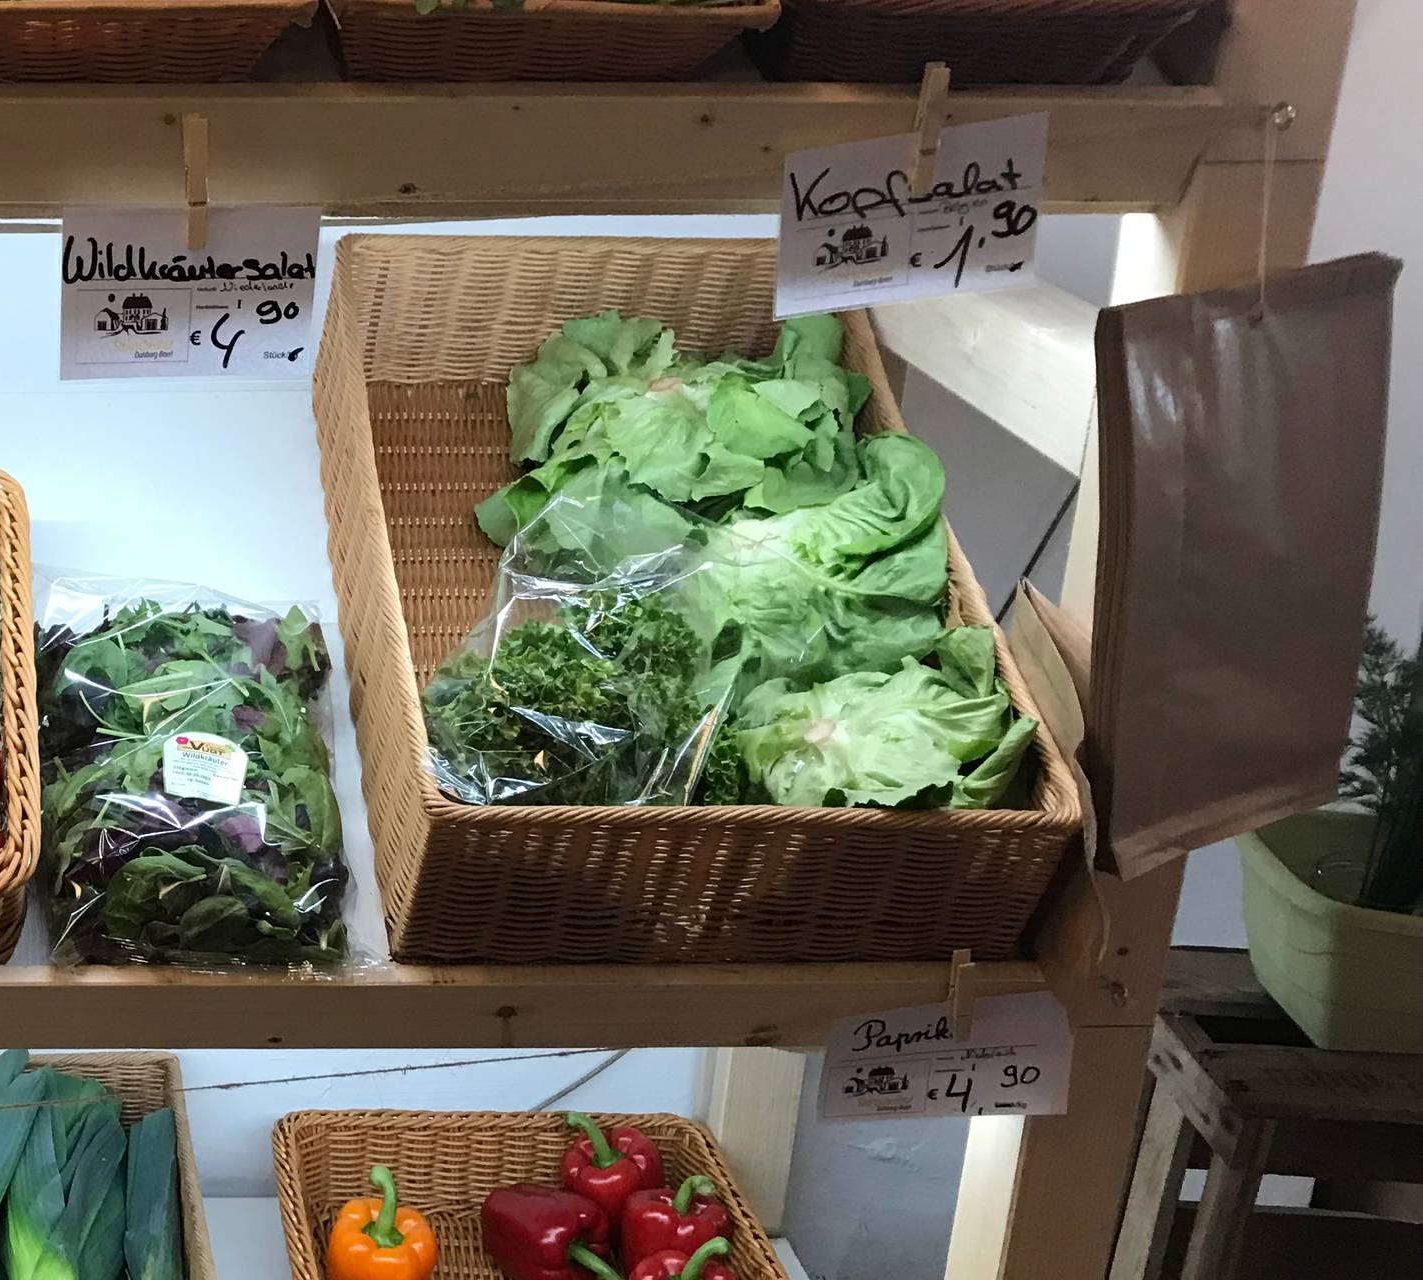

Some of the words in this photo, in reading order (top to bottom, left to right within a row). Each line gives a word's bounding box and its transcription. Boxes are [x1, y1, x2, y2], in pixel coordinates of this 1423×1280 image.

[910, 252, 921, 267] €
[190, 331, 201, 345] €
[852, 1016, 954, 1052] Paprik
